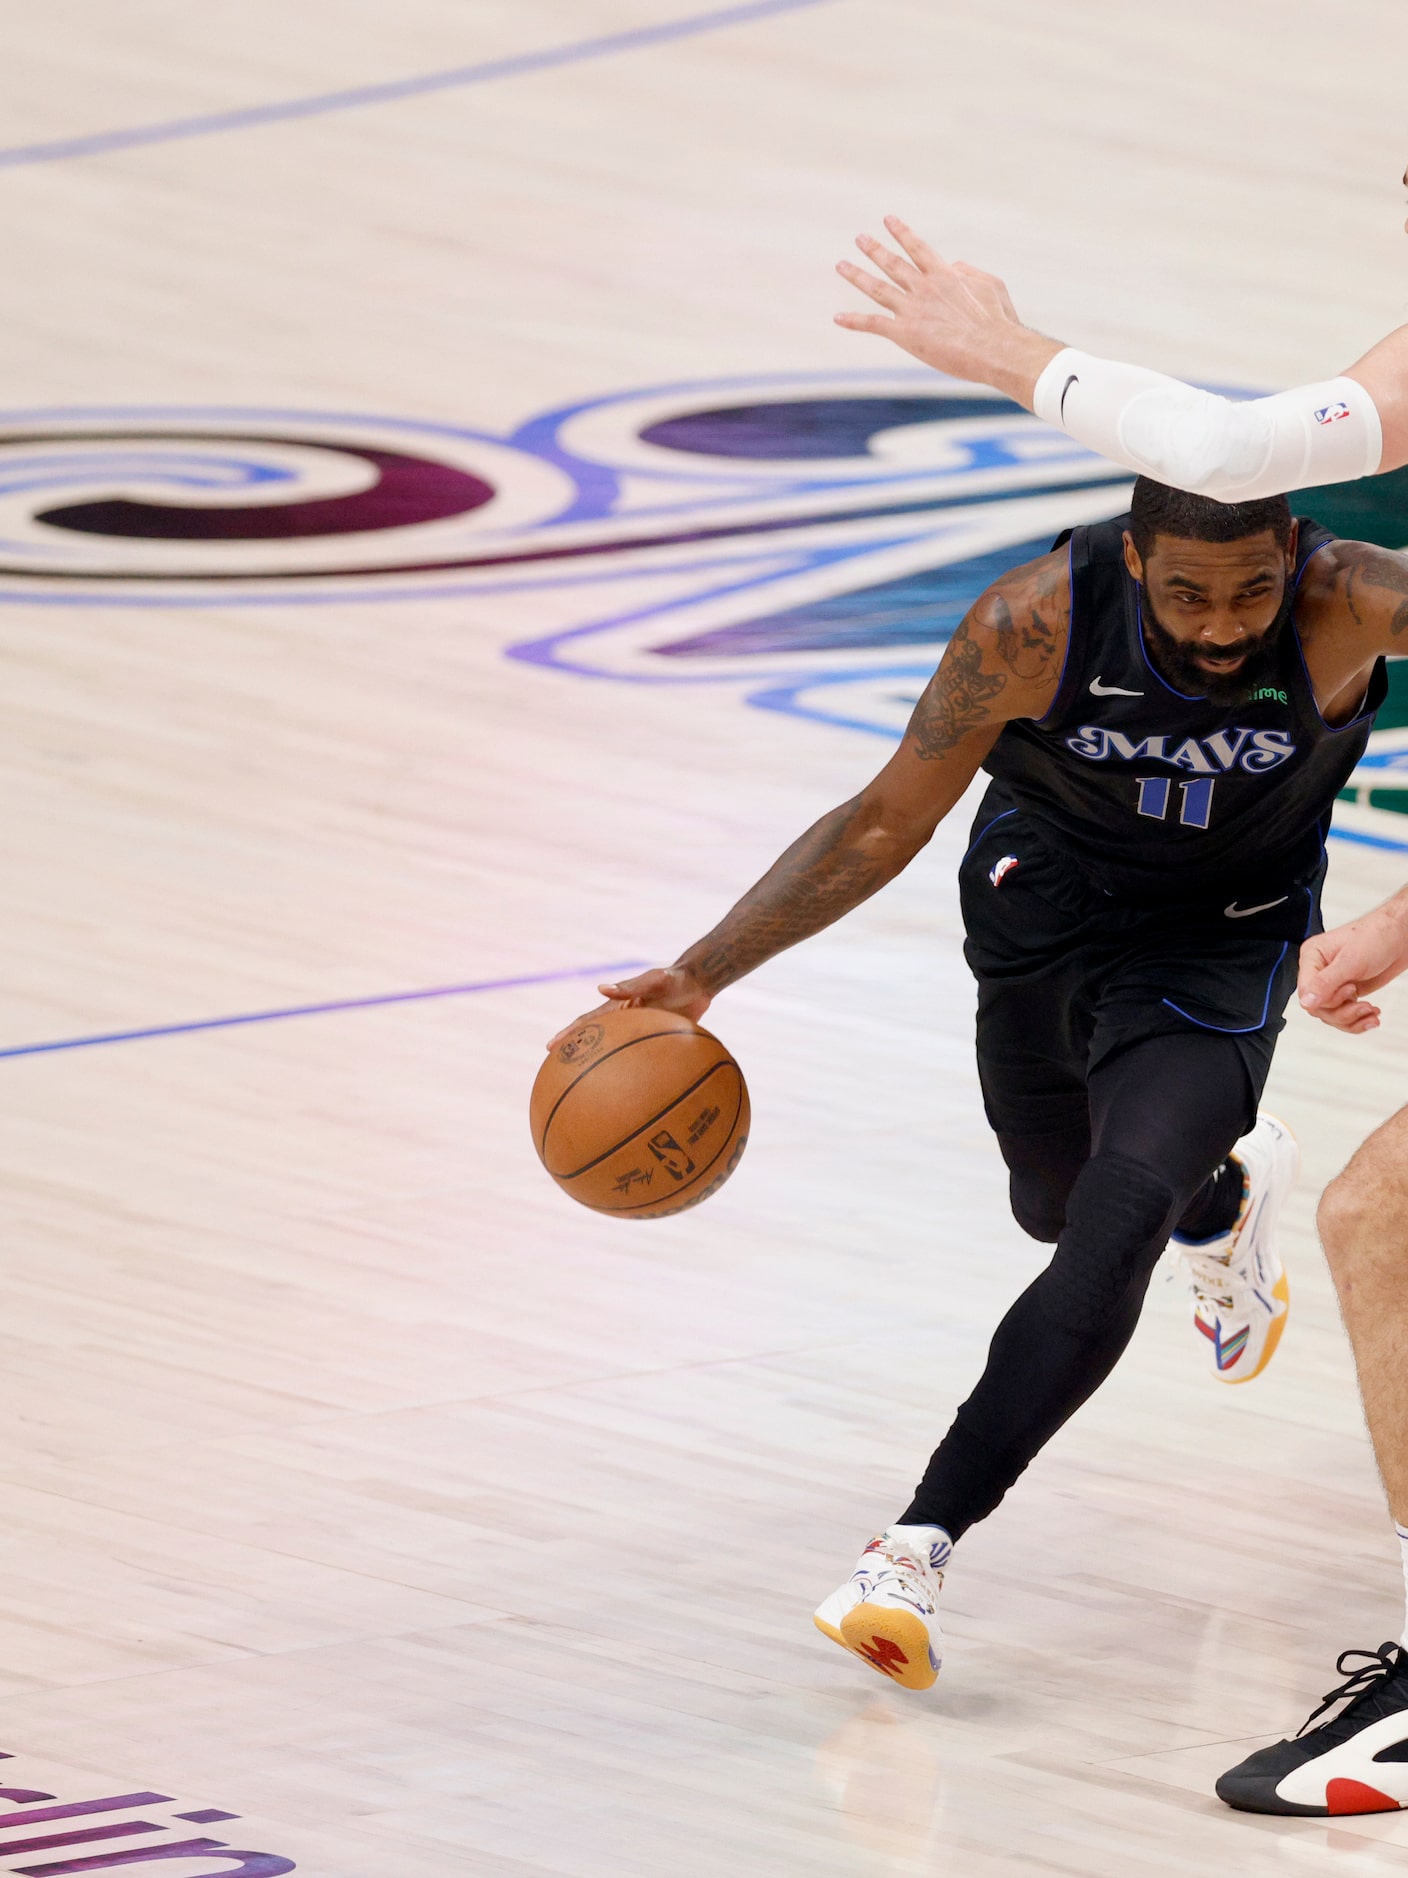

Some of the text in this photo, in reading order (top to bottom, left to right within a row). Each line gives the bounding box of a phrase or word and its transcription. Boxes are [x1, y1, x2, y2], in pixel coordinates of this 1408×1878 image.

[1249, 683, 1288, 706] ime
[1065, 725, 1297, 774] MAVS
[1135, 776, 1216, 829] 11
